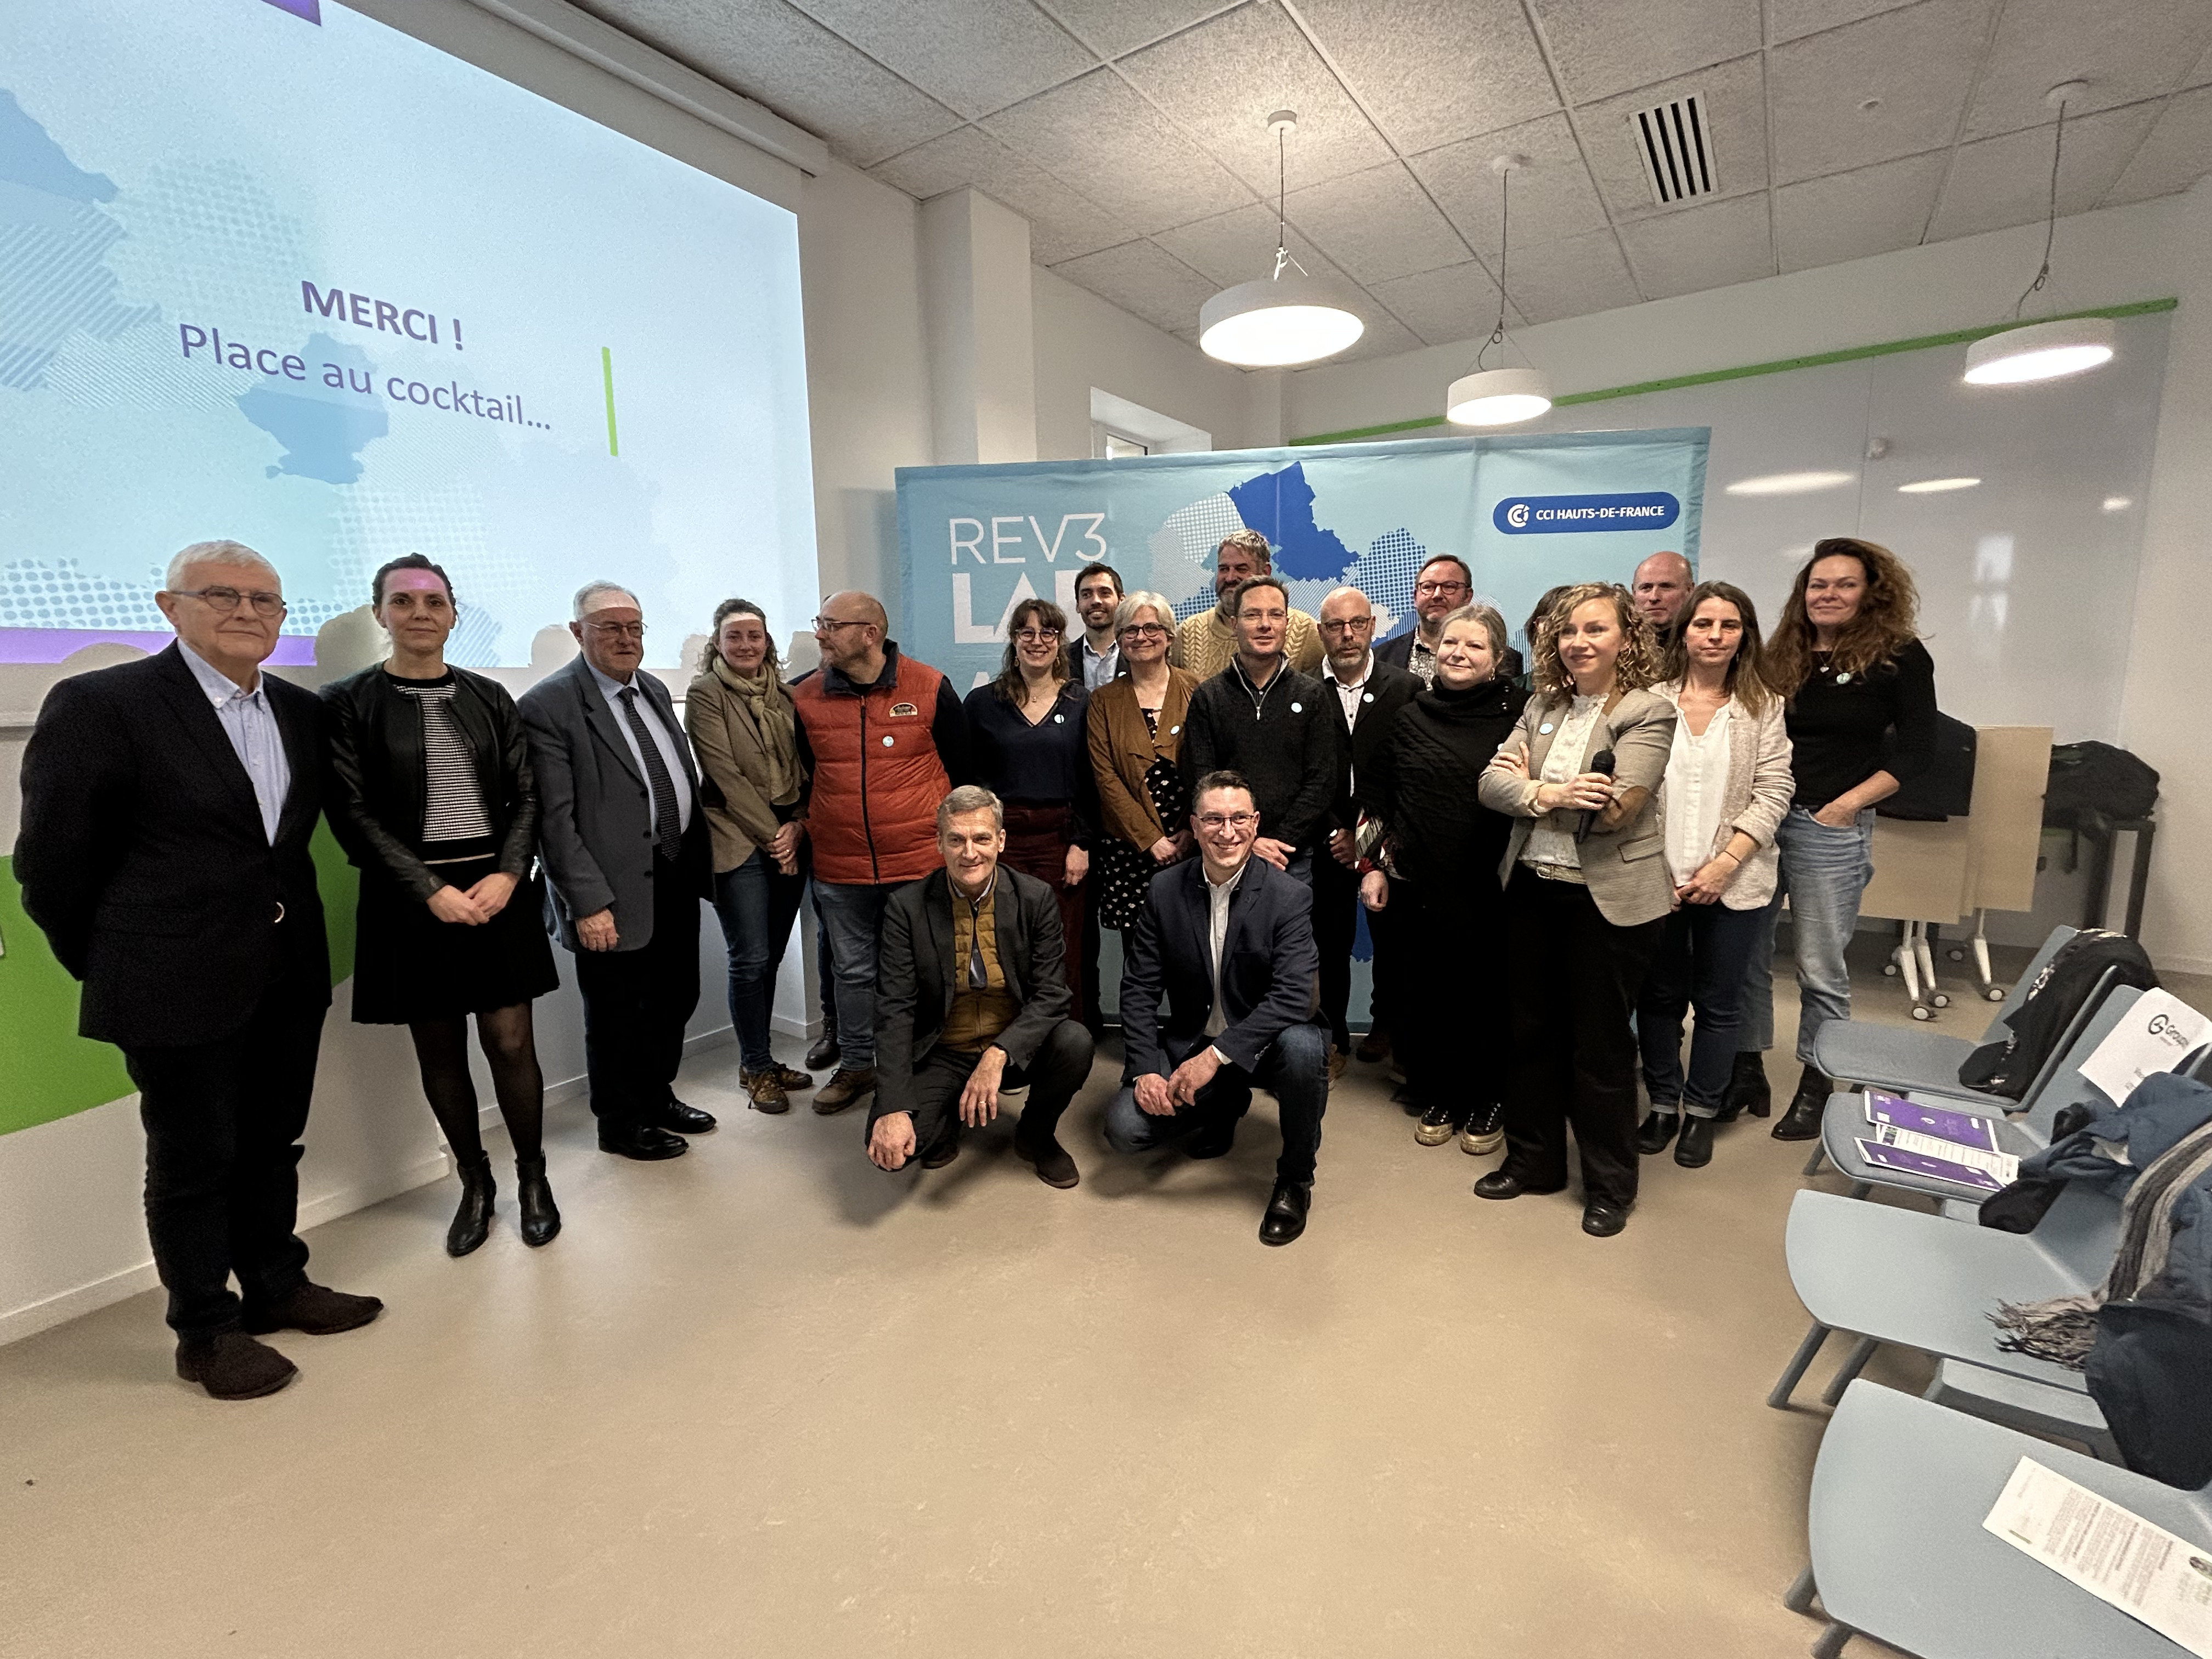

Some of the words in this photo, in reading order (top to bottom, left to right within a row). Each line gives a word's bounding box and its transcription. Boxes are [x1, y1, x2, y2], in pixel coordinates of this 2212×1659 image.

[301, 280, 439, 344] MERCI
[179, 323, 307, 381] Place
[321, 360, 373, 395] au
[949, 512, 1107, 565] REV3
[1536, 509, 1554, 521] CCI
[1556, 505, 1664, 520] HAUTS-DE-FRANCE
